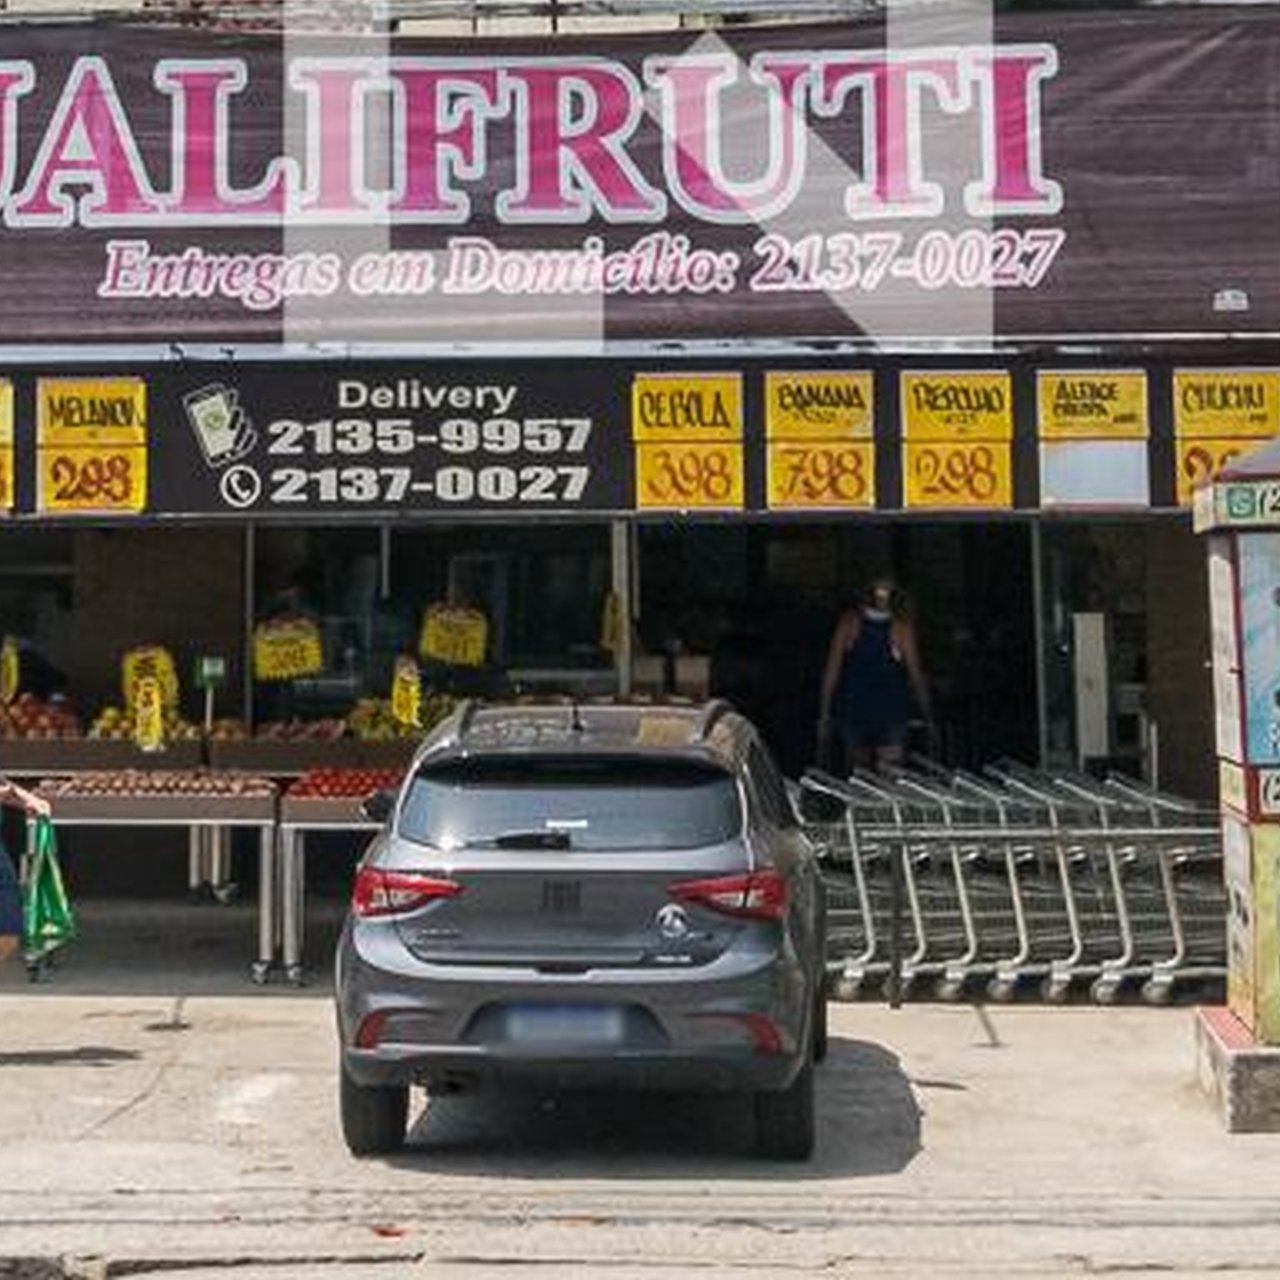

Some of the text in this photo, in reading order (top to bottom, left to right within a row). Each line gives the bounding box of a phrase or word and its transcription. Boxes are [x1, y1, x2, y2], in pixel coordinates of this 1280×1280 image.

[99, 229, 1065, 311] Entregas em Domicílio: 2137-0027
[338, 380, 518, 415] Delivery
[639, 391, 731, 428] CEBOLA
[267, 418, 594, 456] 2135-9957
[270, 465, 591, 503] 2137-0027
